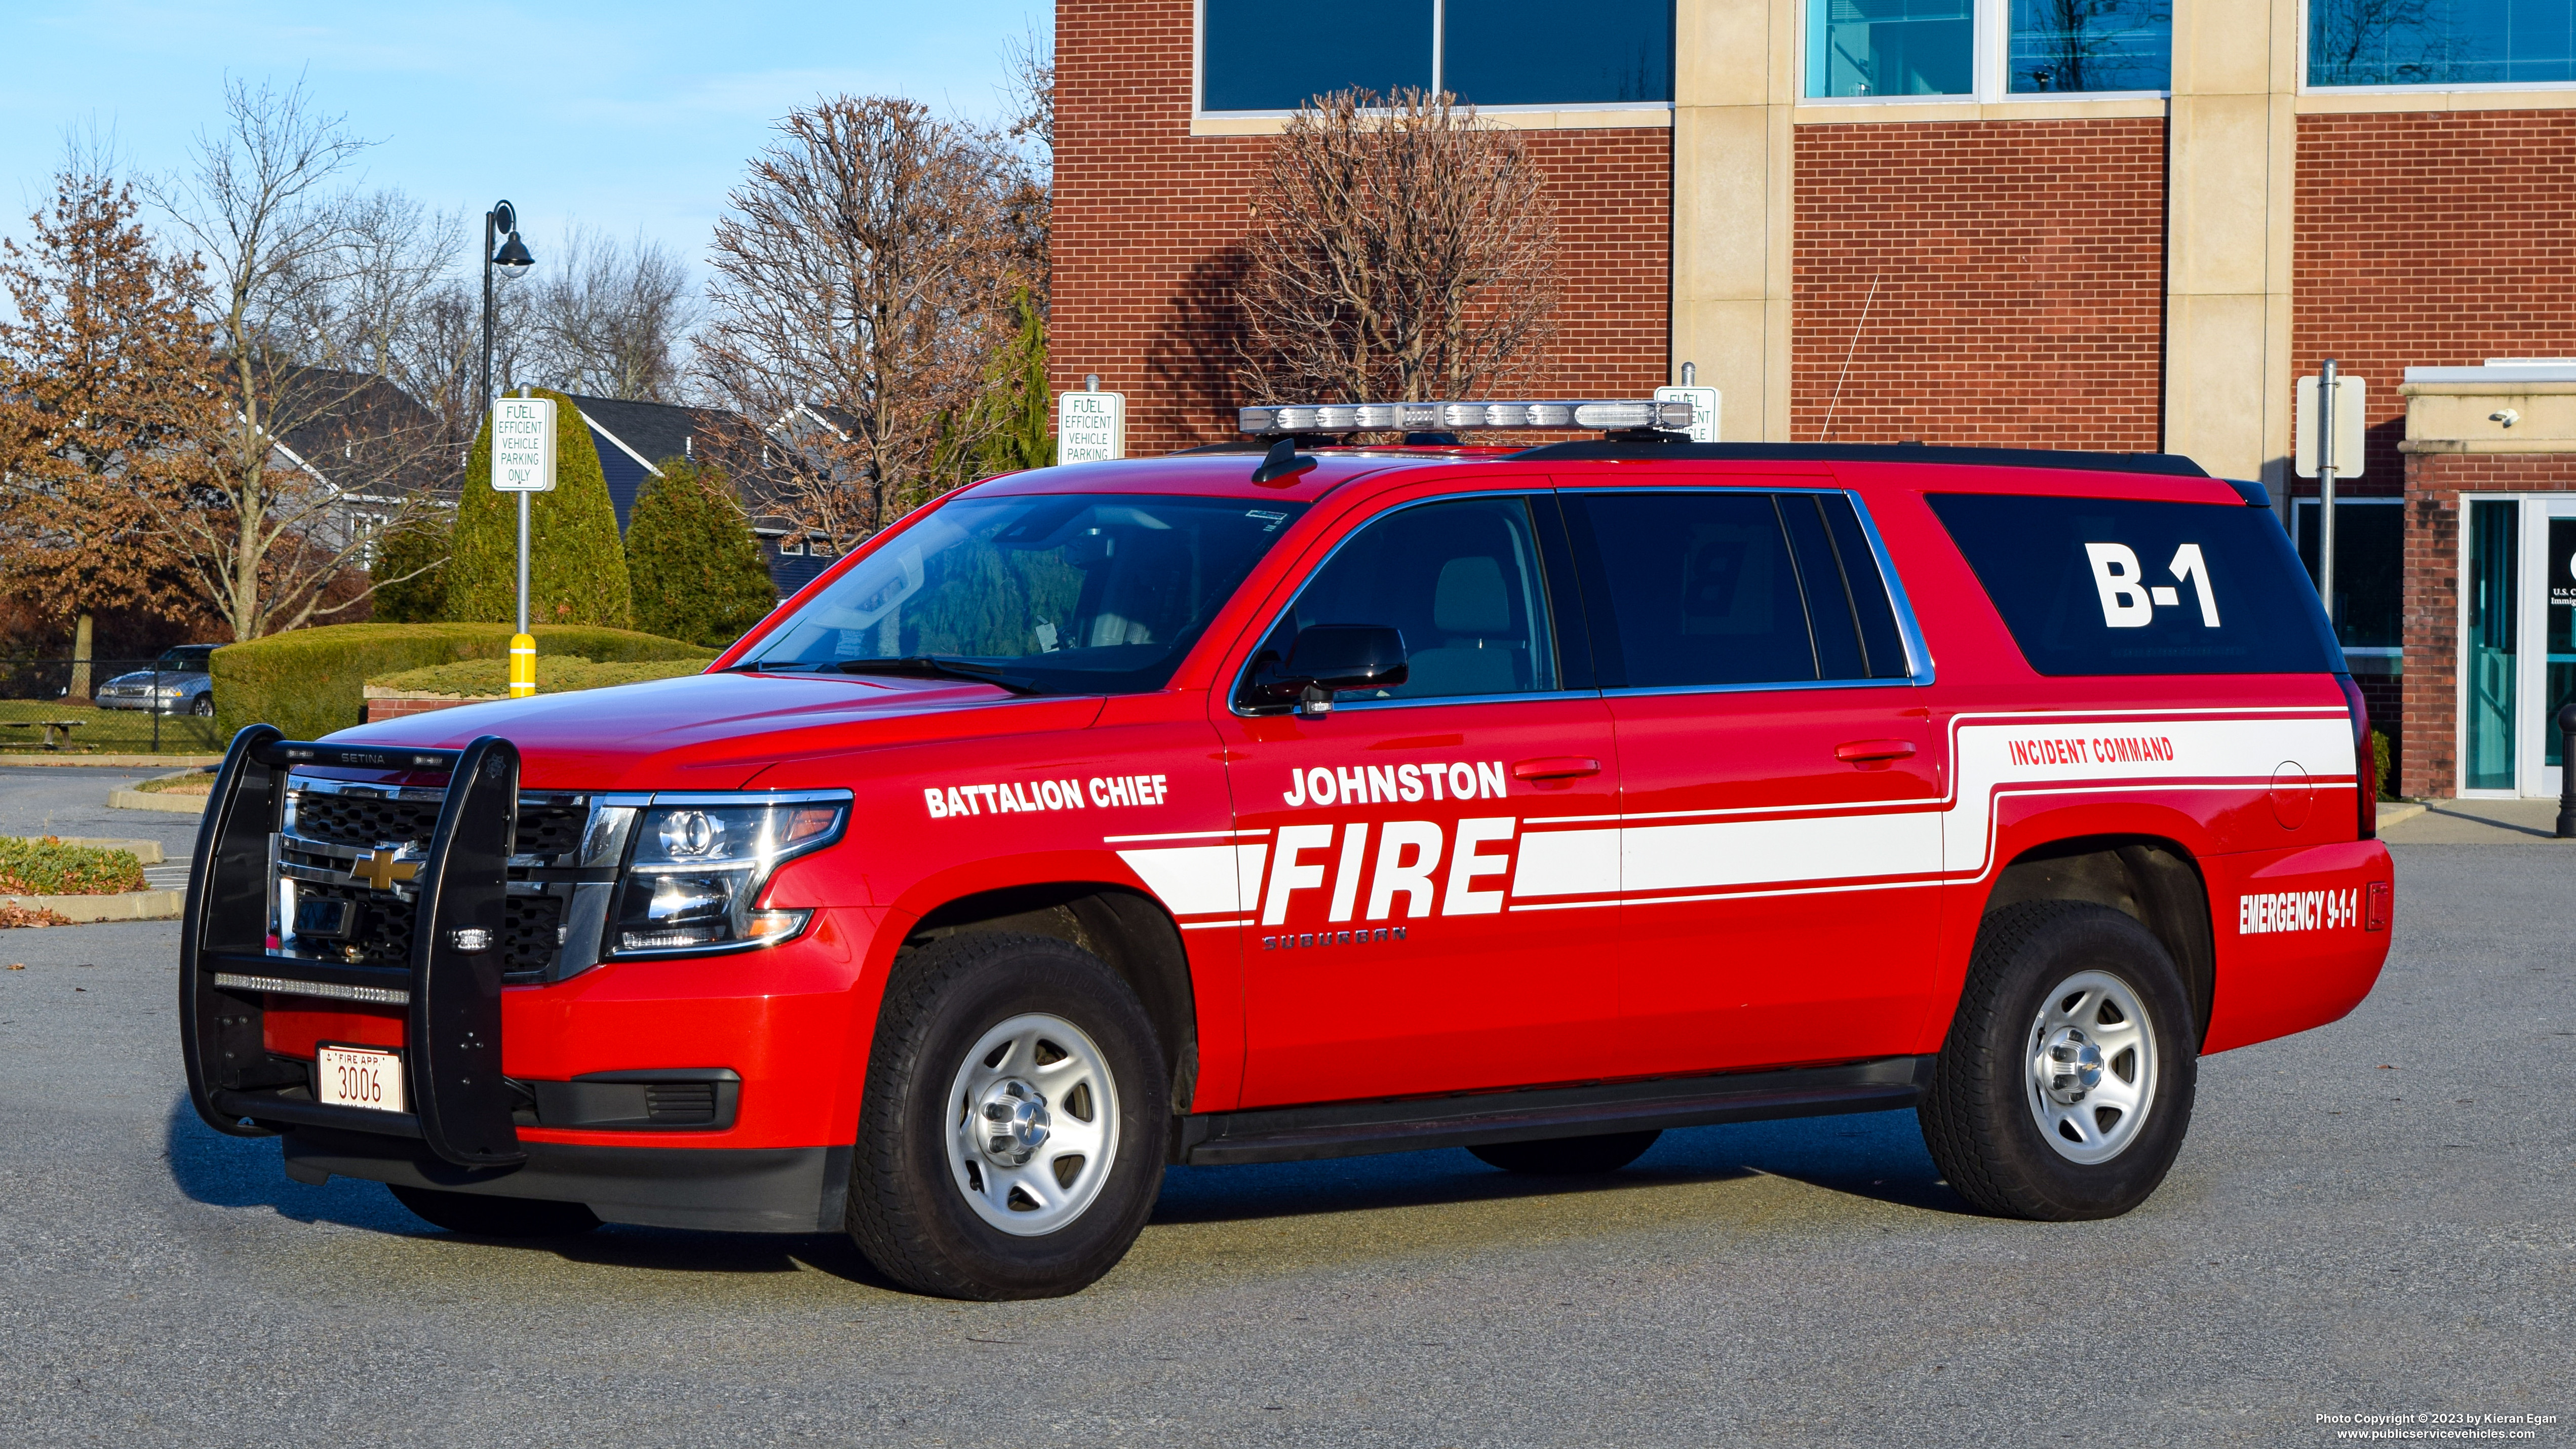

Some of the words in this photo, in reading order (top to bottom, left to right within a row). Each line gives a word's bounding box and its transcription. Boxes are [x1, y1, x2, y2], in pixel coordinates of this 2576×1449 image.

[506, 406, 536, 419] FUEL
[1074, 400, 1105, 413] FUEL
[499, 421, 542, 434] EFFICIENT
[1065, 415, 1112, 429] EFFICIENT
[502, 438, 539, 449] VEHICLE
[1069, 433, 1108, 445] VEHICLE
[501, 453, 539, 465] PARKING
[1067, 448, 1108, 460] PARKING
[509, 469, 531, 481] ONLY
[2084, 542, 2220, 628] B-1
[2008, 739, 2088, 766] INCIDENT
[2092, 736, 2173, 763] COMMAND
[341, 753, 385, 764] SETINA
[1283, 761, 1507, 807] JOHNSTON
[924, 779, 1085, 818] BATTALION
[1089, 774, 1167, 808] CHIEF
[1262, 816, 1516, 926] FIRE
[2239, 890, 2325, 934] EMERGENCY
[2327, 888, 2357, 929] 9-1-1
[1262, 926, 1407, 951] SUBURBAN
[339, 1054, 358, 1064] FIRE
[338, 1065, 381, 1102] 3006
